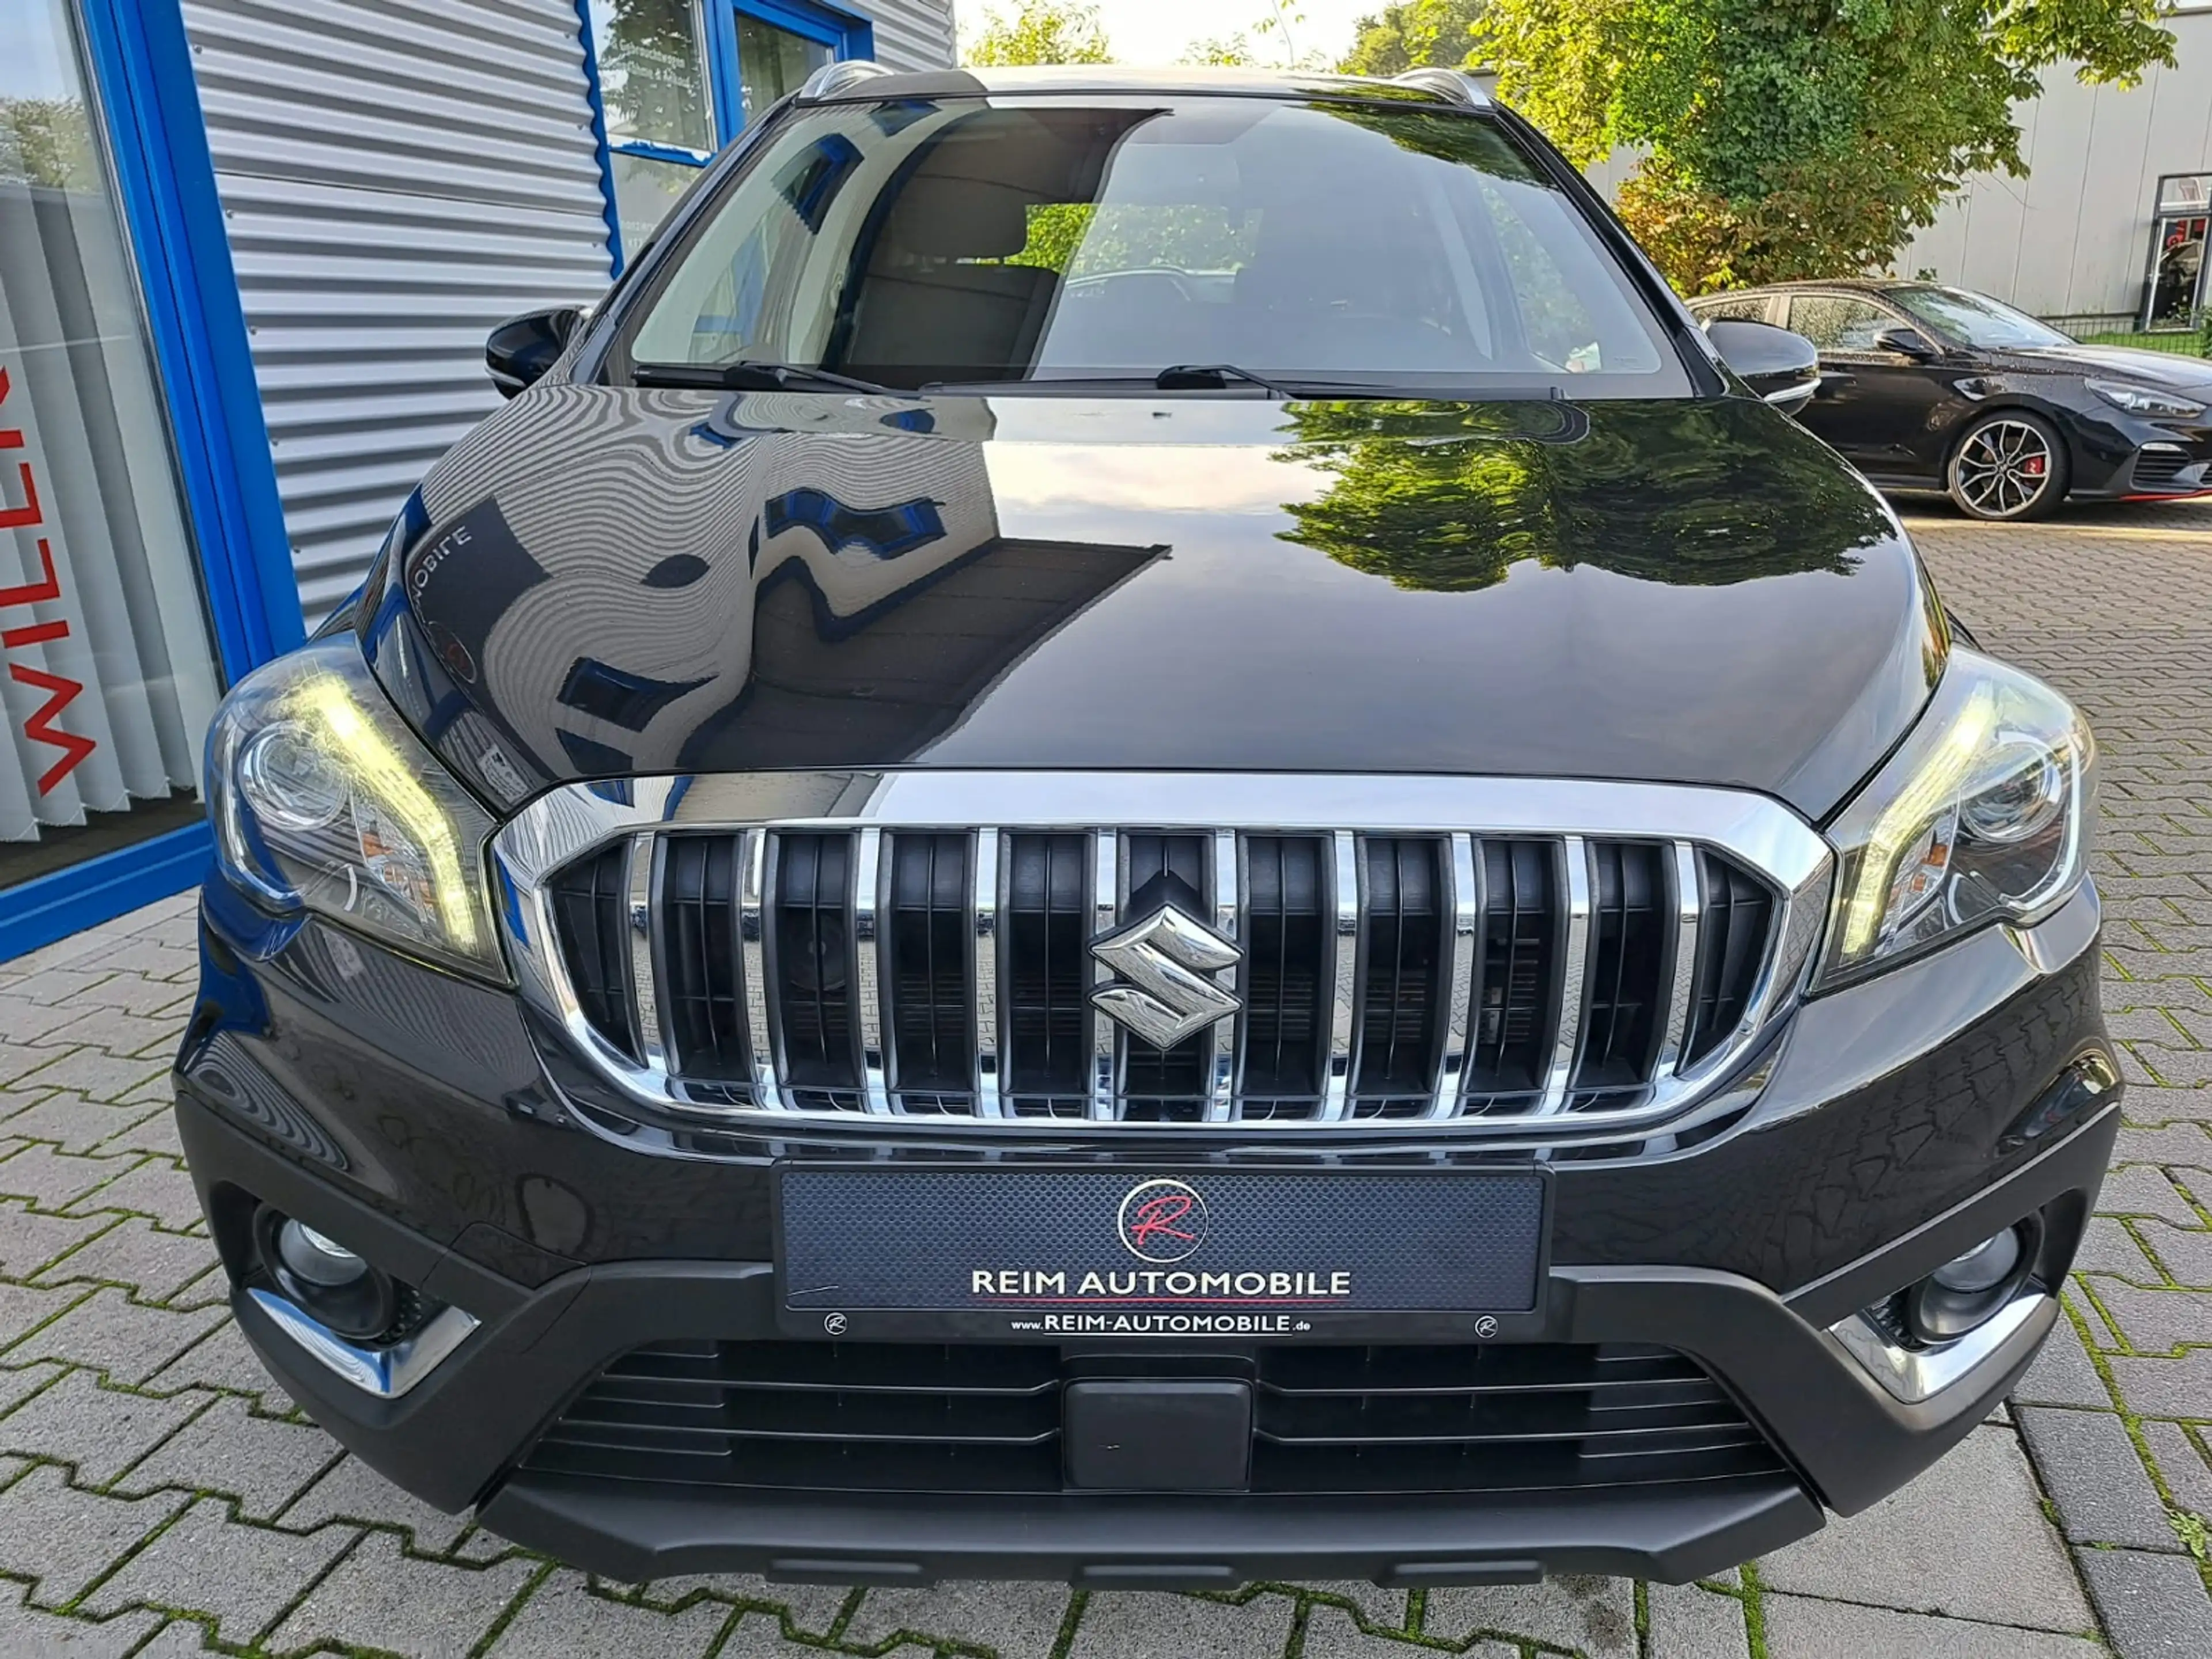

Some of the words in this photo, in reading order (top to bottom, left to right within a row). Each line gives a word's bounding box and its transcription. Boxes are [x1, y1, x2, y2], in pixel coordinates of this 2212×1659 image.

[972, 1270, 1065, 1294] REIM
[1077, 1271, 1351, 1295] AUTOMOBILE
[1011, 1315, 1310, 1332] www.REIM-AUTOMOBILE.de
